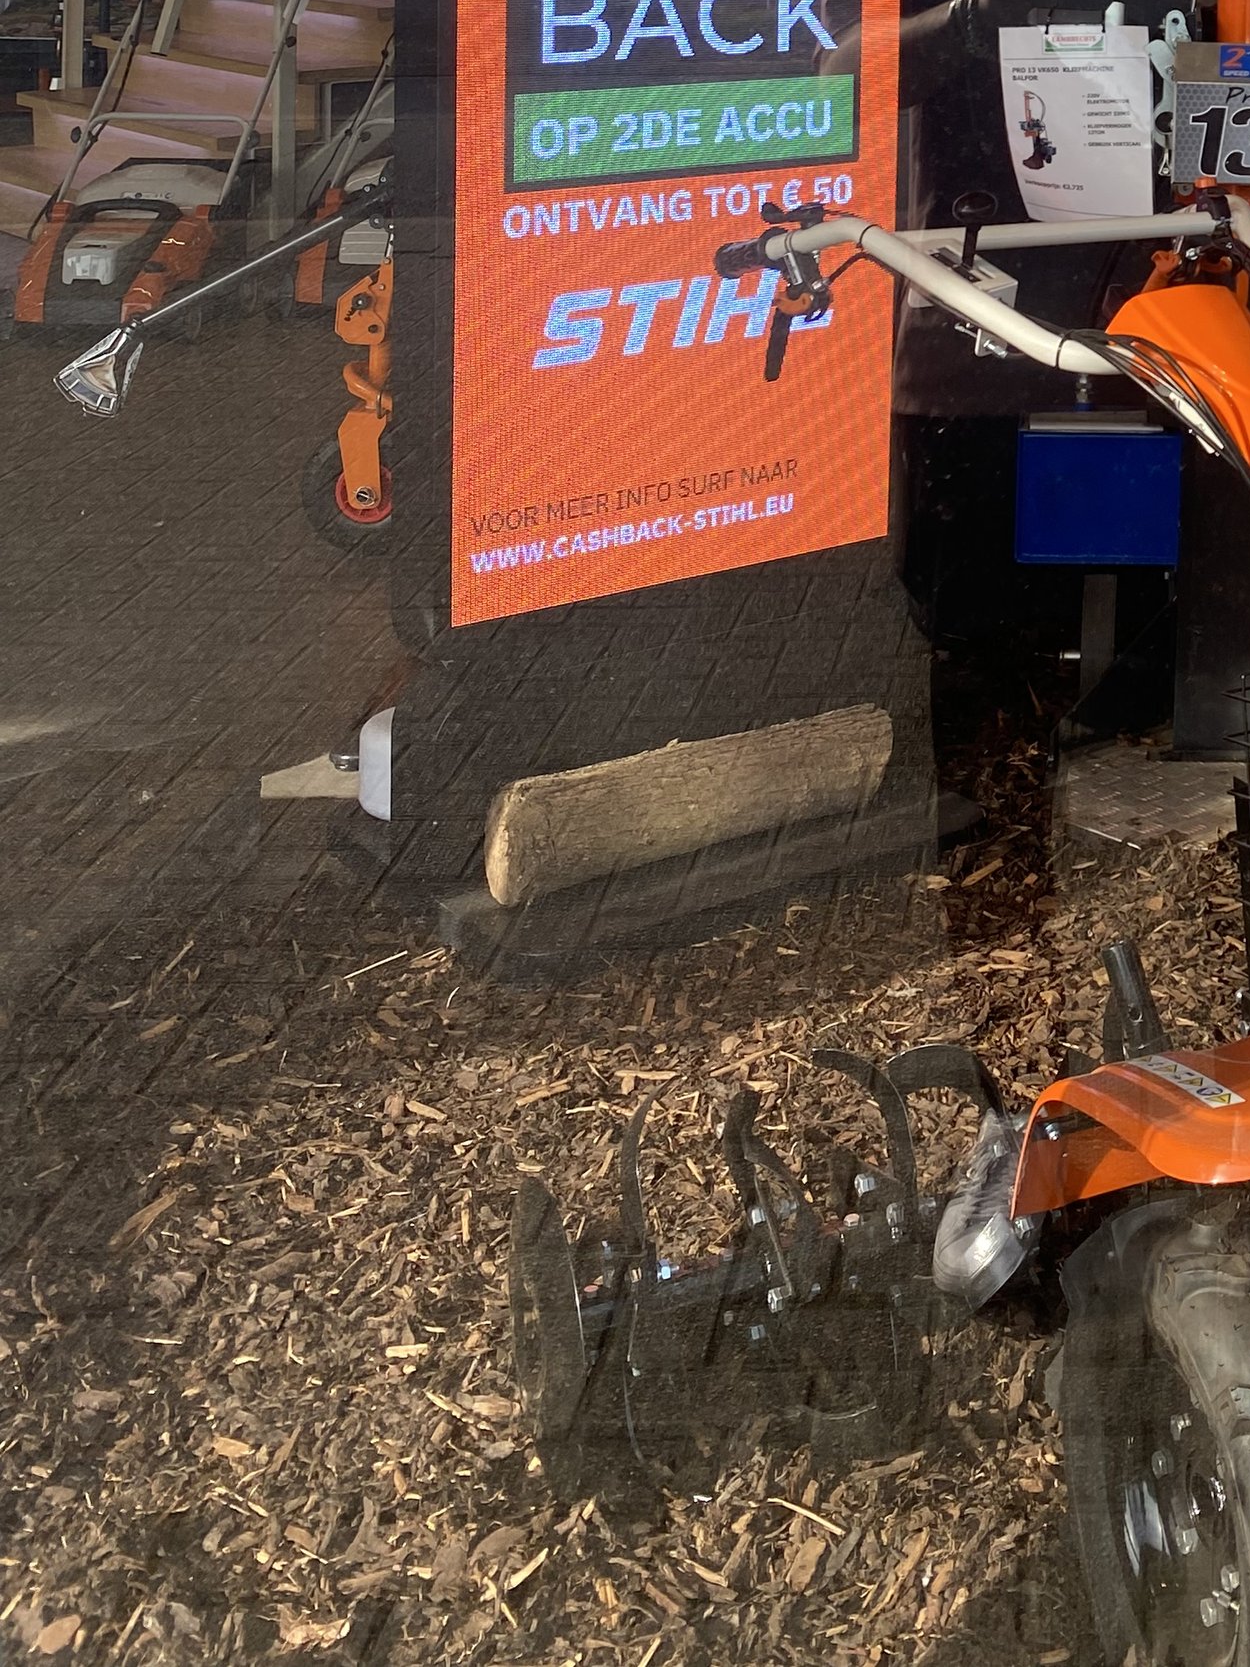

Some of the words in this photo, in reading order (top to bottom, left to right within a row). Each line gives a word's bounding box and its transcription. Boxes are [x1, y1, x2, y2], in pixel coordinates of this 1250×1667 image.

[531, 116, 599, 160] OP
[611, 109, 703, 152] 2DE
[714, 100, 833, 143] ACCU
[503, 189, 692, 239] ONTVANG
[703, 182, 773, 218] TOT
[813, 174, 853, 206] 50
[469, 492, 795, 574] WWW.CASHBACK-STIHL.EU
[471, 505, 540, 536] VOOR
[547, 493, 609, 524] MEER
[615, 481, 673, 511] INFO
[677, 470, 734, 499] SURF
[740, 459, 798, 485] NAAR
